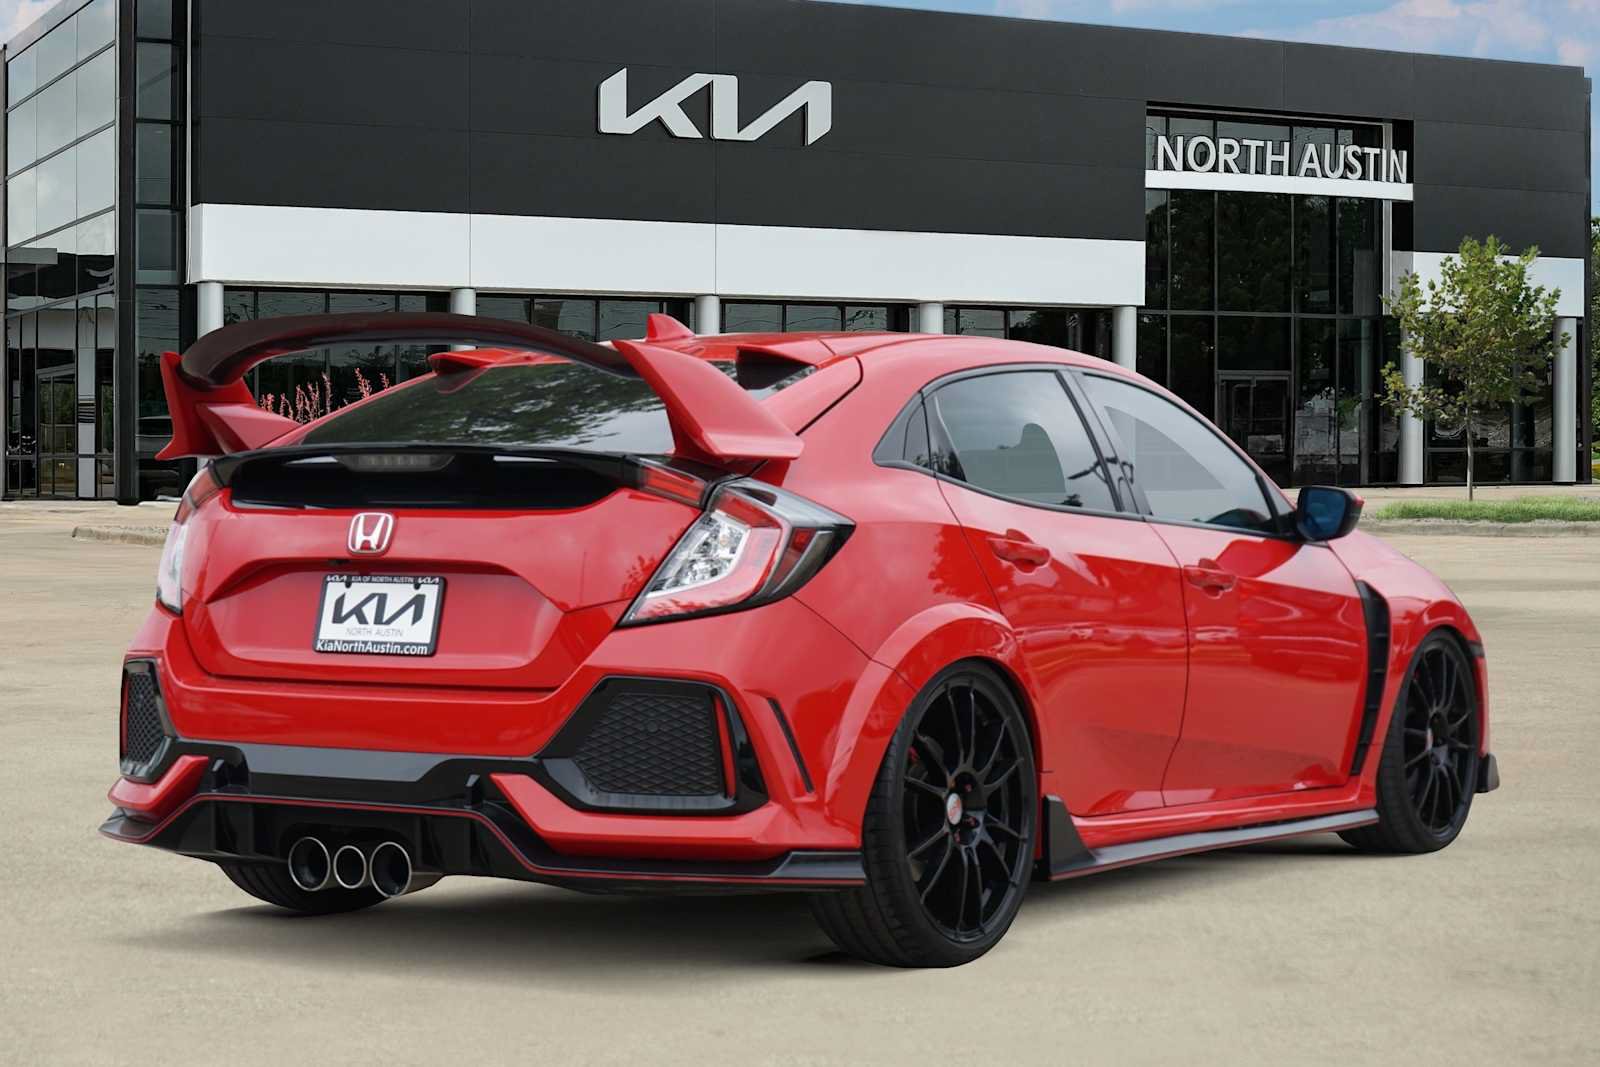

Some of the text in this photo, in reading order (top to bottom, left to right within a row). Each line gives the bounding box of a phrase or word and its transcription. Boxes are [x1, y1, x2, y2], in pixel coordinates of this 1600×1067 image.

[598, 67, 832, 146] KIA
[1157, 135, 1407, 184] NORTH AUSTIN
[332, 592, 426, 626] KIA
[315, 640, 428, 655] KiaNorthAustin.com
[346, 627, 403, 637] NORTH AUSTIN
